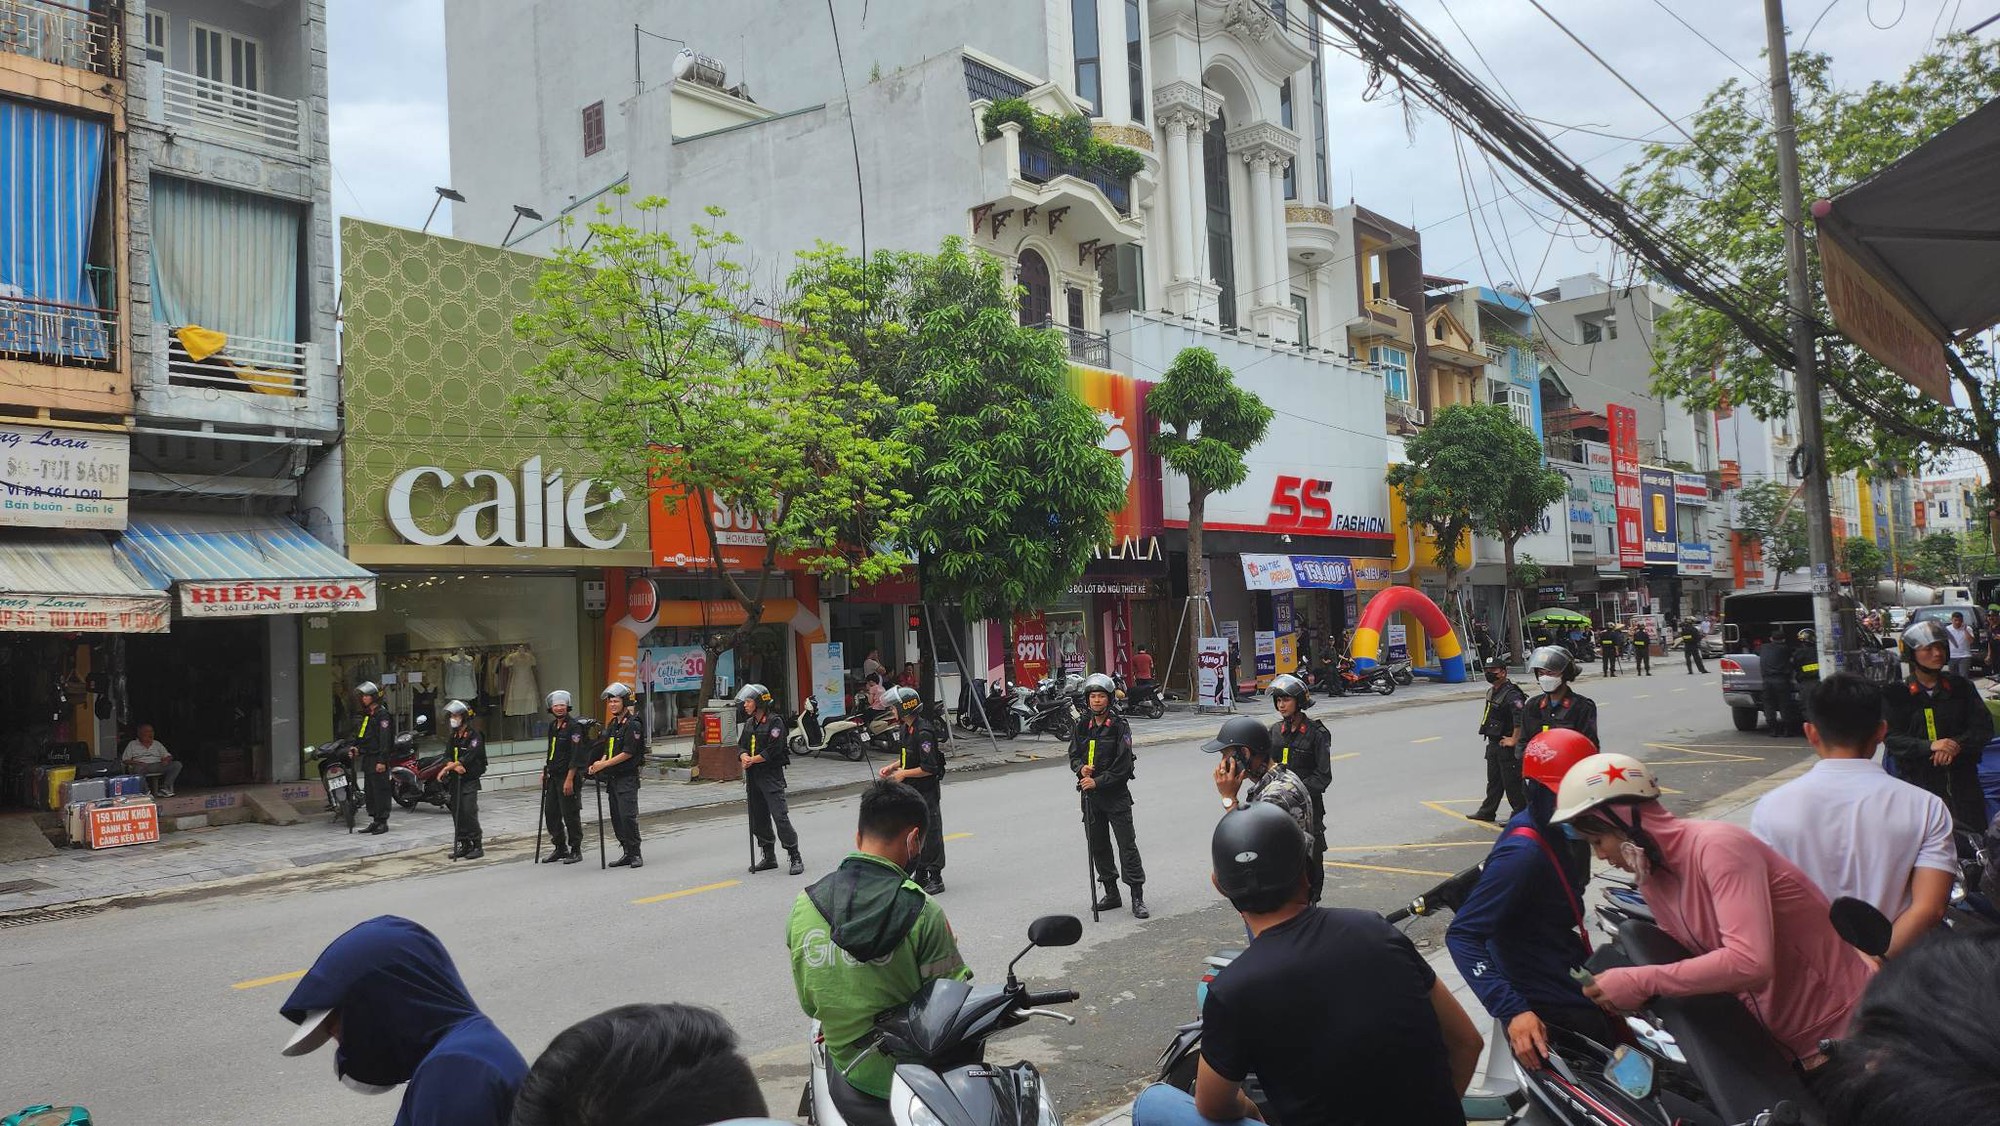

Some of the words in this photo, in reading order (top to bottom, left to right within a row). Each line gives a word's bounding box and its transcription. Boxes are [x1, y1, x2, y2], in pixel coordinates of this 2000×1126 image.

[30, 430, 89, 449] Loan
[386, 455, 628, 549] calie
[1336, 514, 1386, 532] FASHION
[725, 535, 748, 544] HOME
[293, 584, 367, 600] HOA
[1017, 642, 1046, 660] 99K
